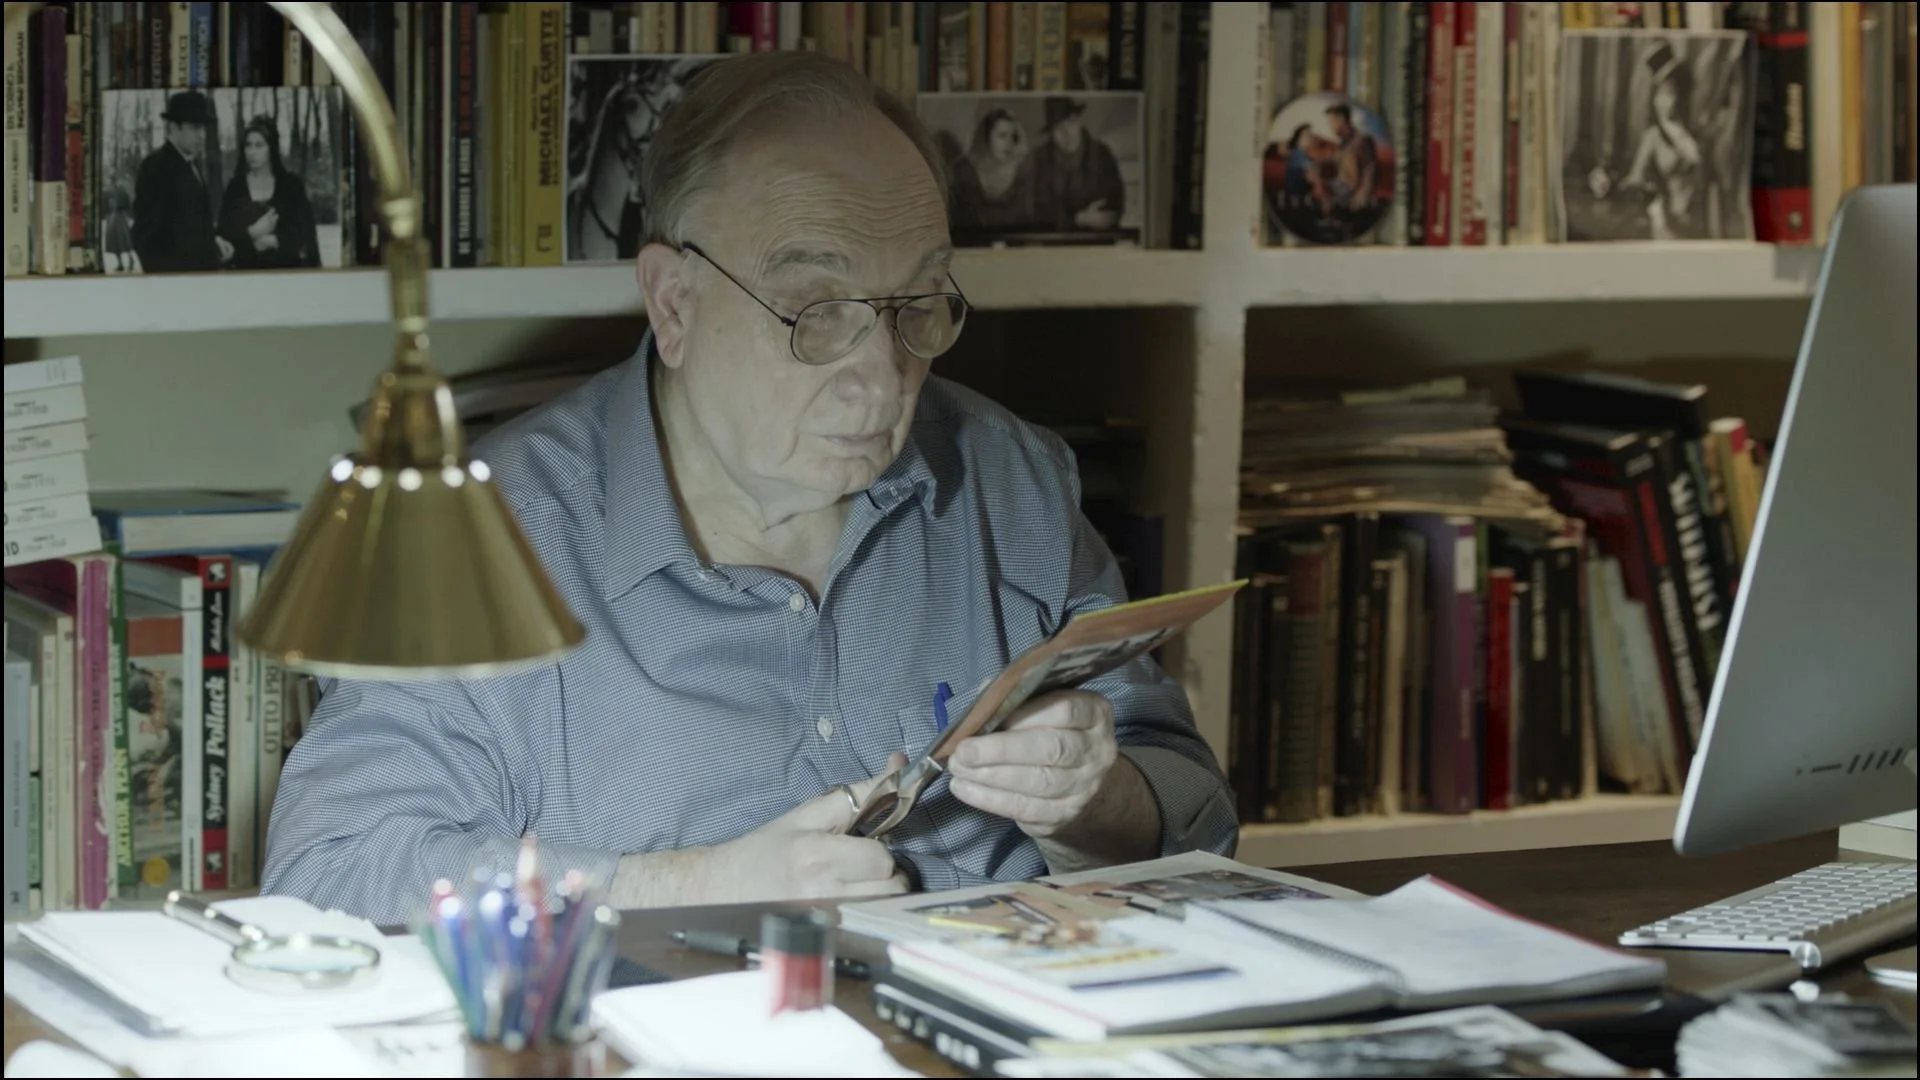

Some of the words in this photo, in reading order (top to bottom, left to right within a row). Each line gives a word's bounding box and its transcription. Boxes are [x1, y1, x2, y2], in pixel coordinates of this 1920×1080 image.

[539, 9, 553, 84] CURTIZ
[539, 90, 553, 187] MICHAEL
[458, 187, 471, 239] TRAIDORES
[205, 675, 226, 757] Pollack
[264, 699, 280, 755] OTTO
[112, 747, 130, 795] PENN
[206, 763, 224, 822] Sydney
[113, 797, 132, 867] ARTHUR
